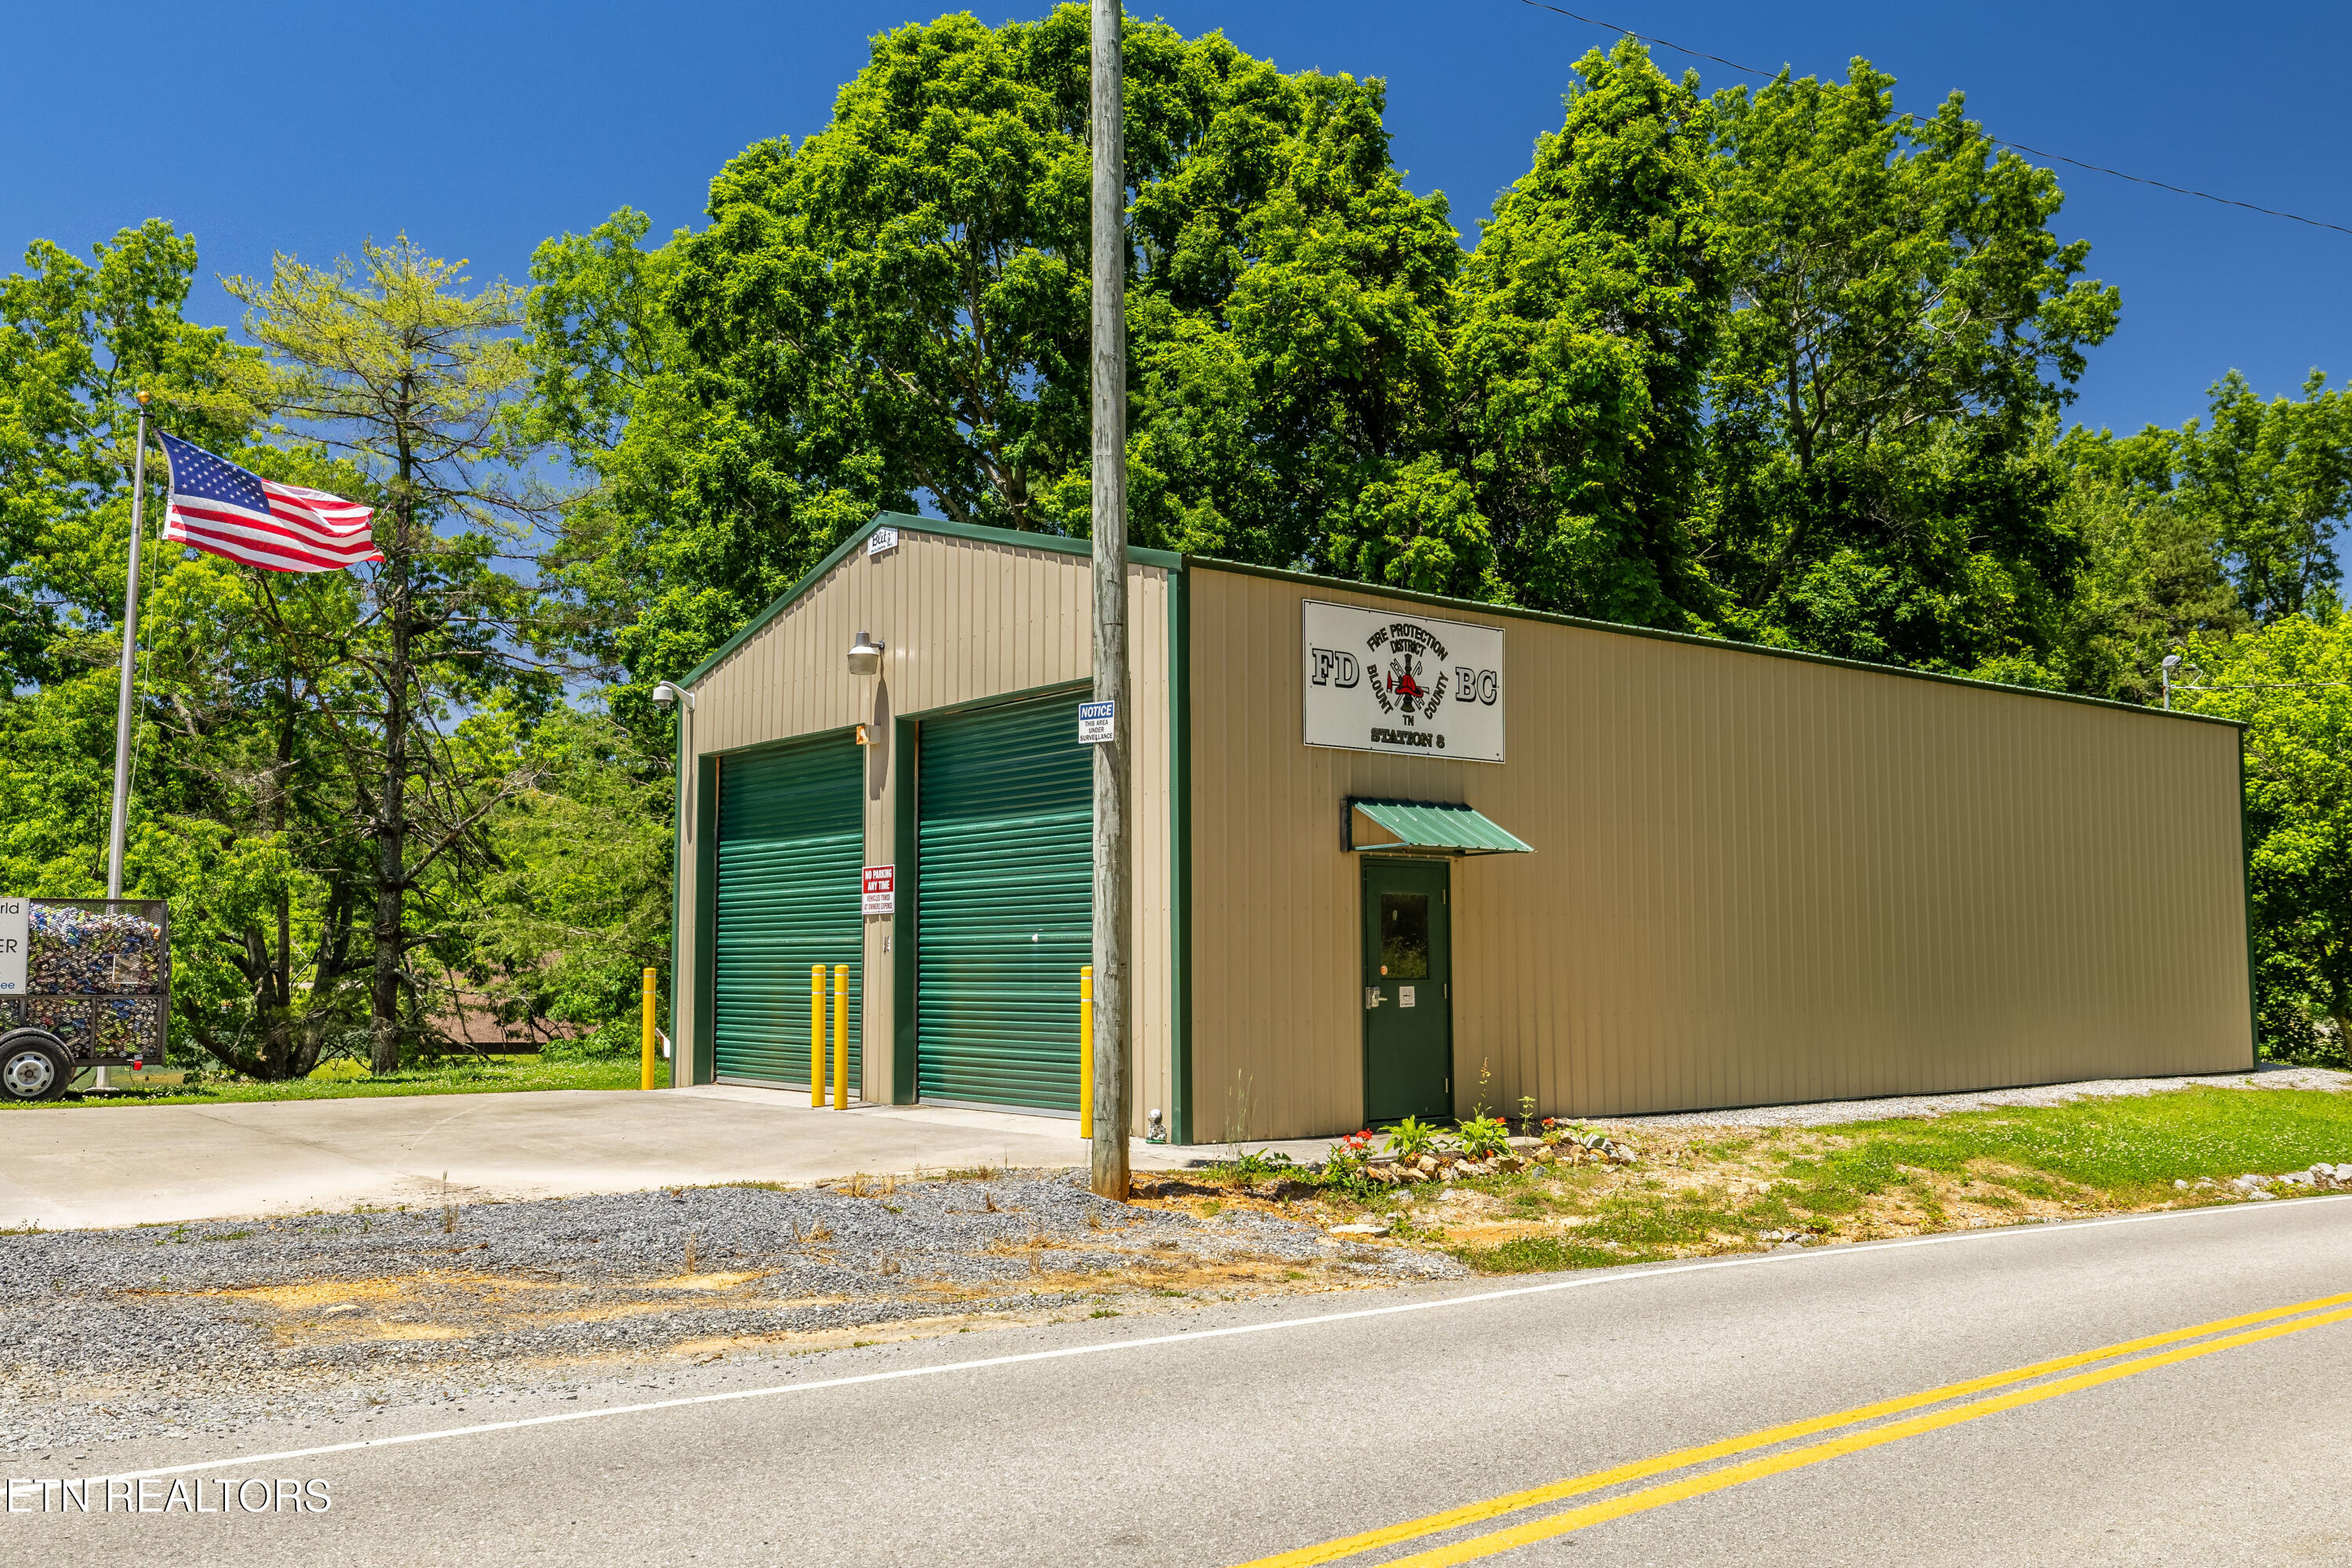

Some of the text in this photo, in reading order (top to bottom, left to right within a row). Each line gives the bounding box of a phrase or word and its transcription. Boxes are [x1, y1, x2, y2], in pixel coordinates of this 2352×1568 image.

[1367, 623, 1449, 662] FIRE PROTECTION
[1390, 639, 1427, 658] DISTRICT
[1312, 648, 1360, 688] FD
[1367, 664, 1394, 715] BLOUNT
[1424, 671, 1449, 720] COUNTY
[1455, 666, 1497, 706] BC
[1081, 704, 1112, 718] NOTICE
[1403, 714, 1414, 726] TN
[1080, 732, 1113, 742] SURVEILLANCE
[1370, 728, 1446, 749] STATION 8
[865, 869, 892, 880] NO PARKING
[867, 880, 890, 891] ANY TIME
